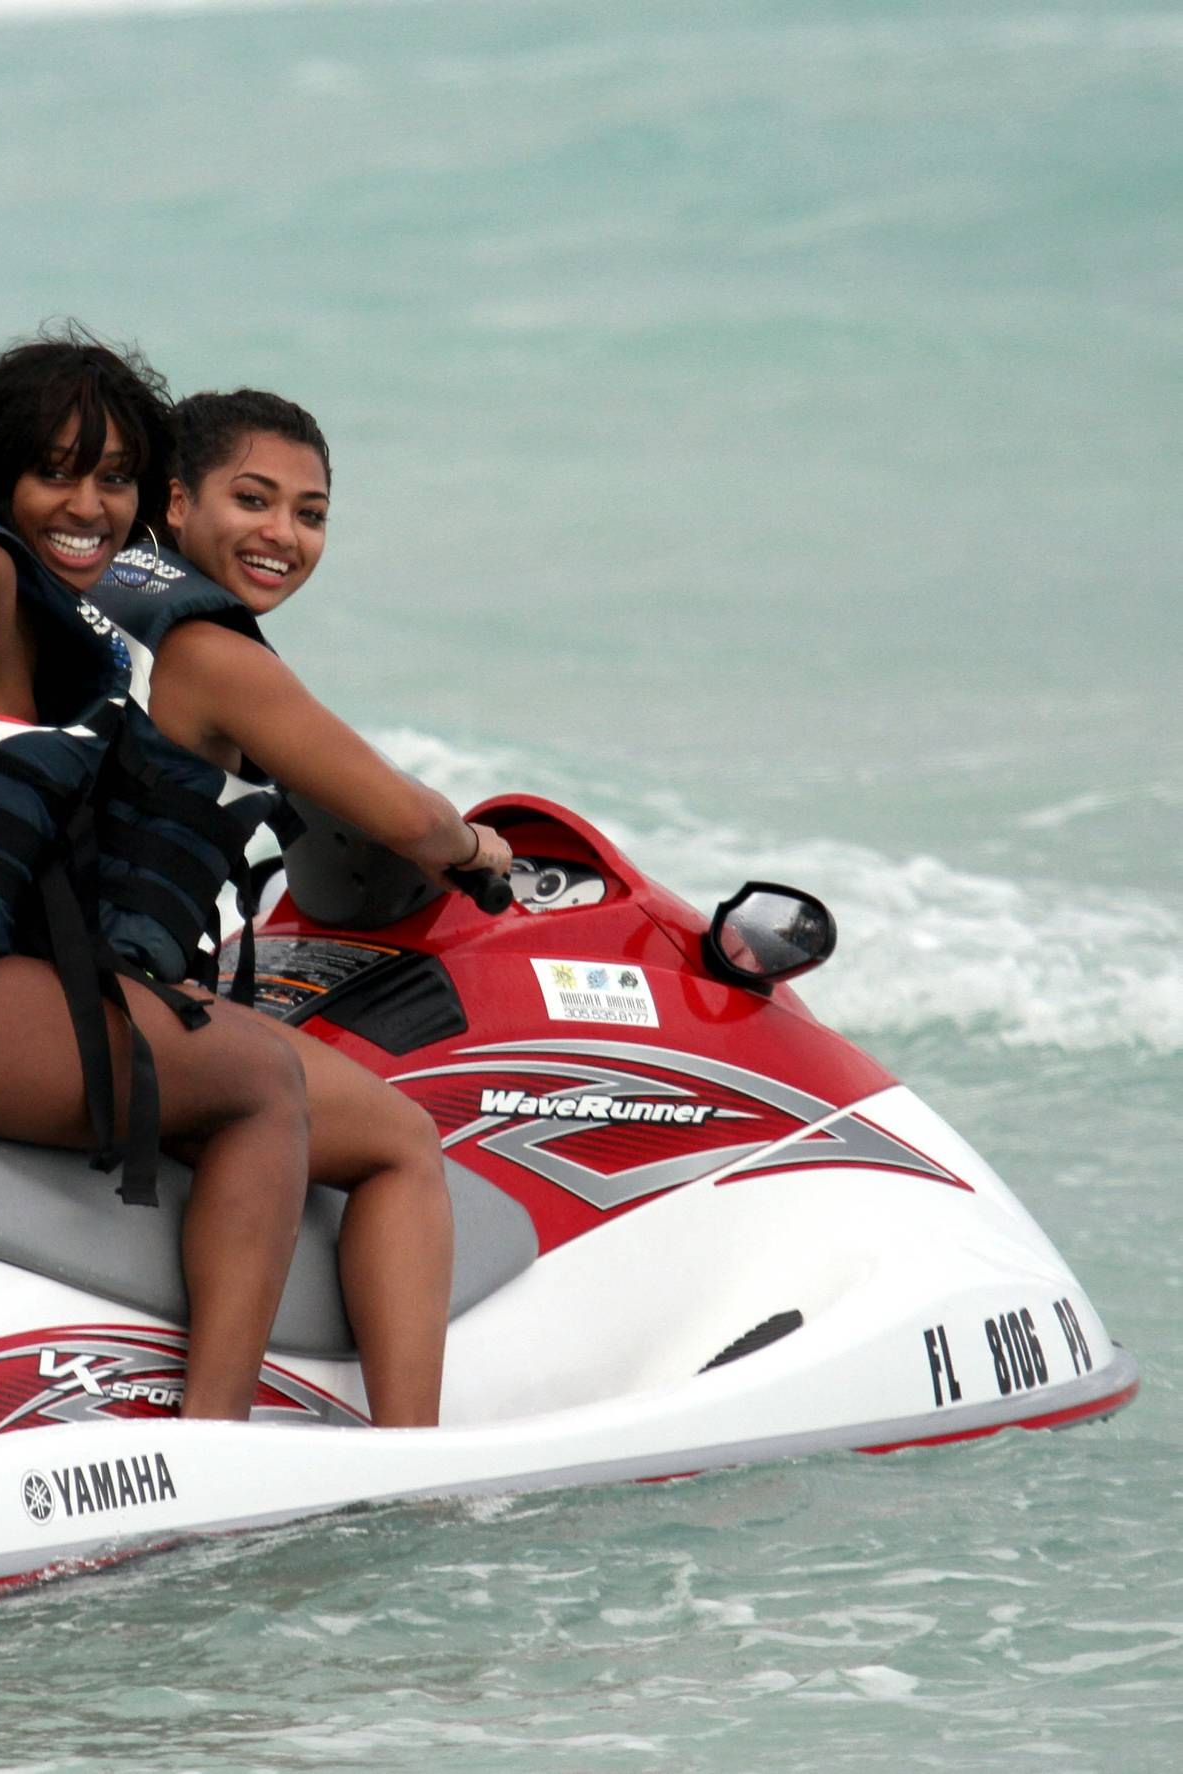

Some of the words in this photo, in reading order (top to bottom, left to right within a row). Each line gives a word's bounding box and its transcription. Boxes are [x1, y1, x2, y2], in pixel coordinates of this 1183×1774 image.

[480, 1089, 714, 1123] WaveRunner
[38, 1348, 115, 1397] VX
[110, 1382, 185, 1408] SPOR
[923, 1324, 963, 1408] FL
[984, 1307, 1049, 1396] 8106
[51, 1452, 177, 1517] YAMAHA
